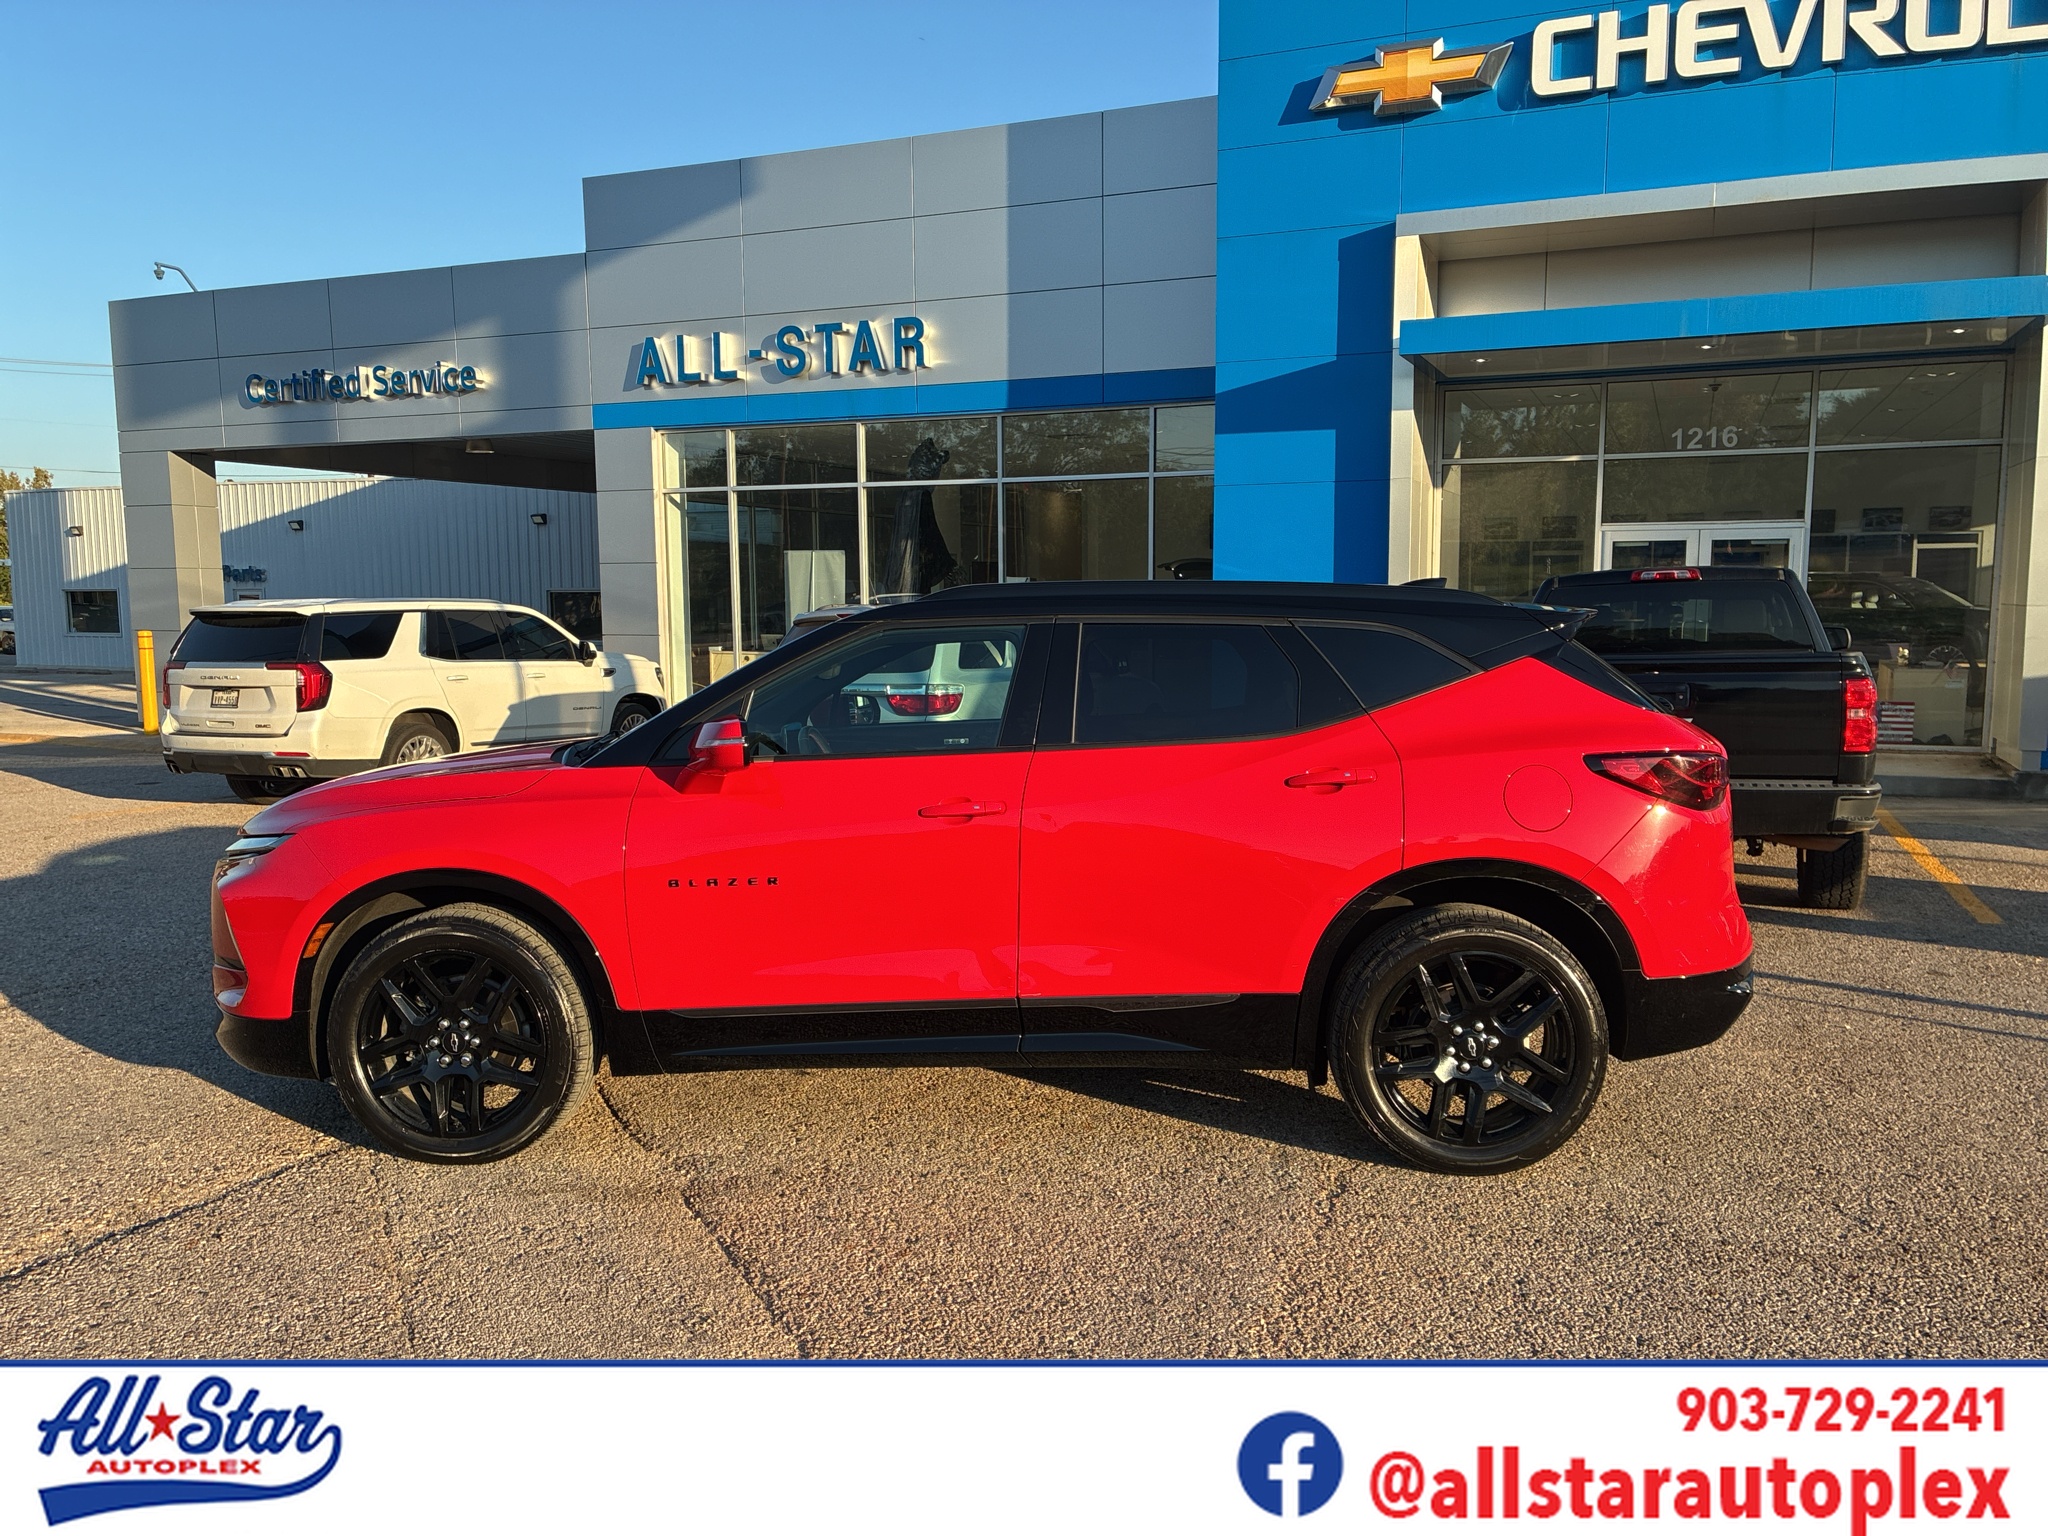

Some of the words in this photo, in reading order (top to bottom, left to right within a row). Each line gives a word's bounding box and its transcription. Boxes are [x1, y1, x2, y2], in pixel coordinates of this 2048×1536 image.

[244, 366, 361, 403] Certified
[372, 361, 478, 396] Service
[1671, 425, 1739, 450] 1216
[222, 564, 263, 582] Parts
[667, 876, 780, 889] BLAZER
